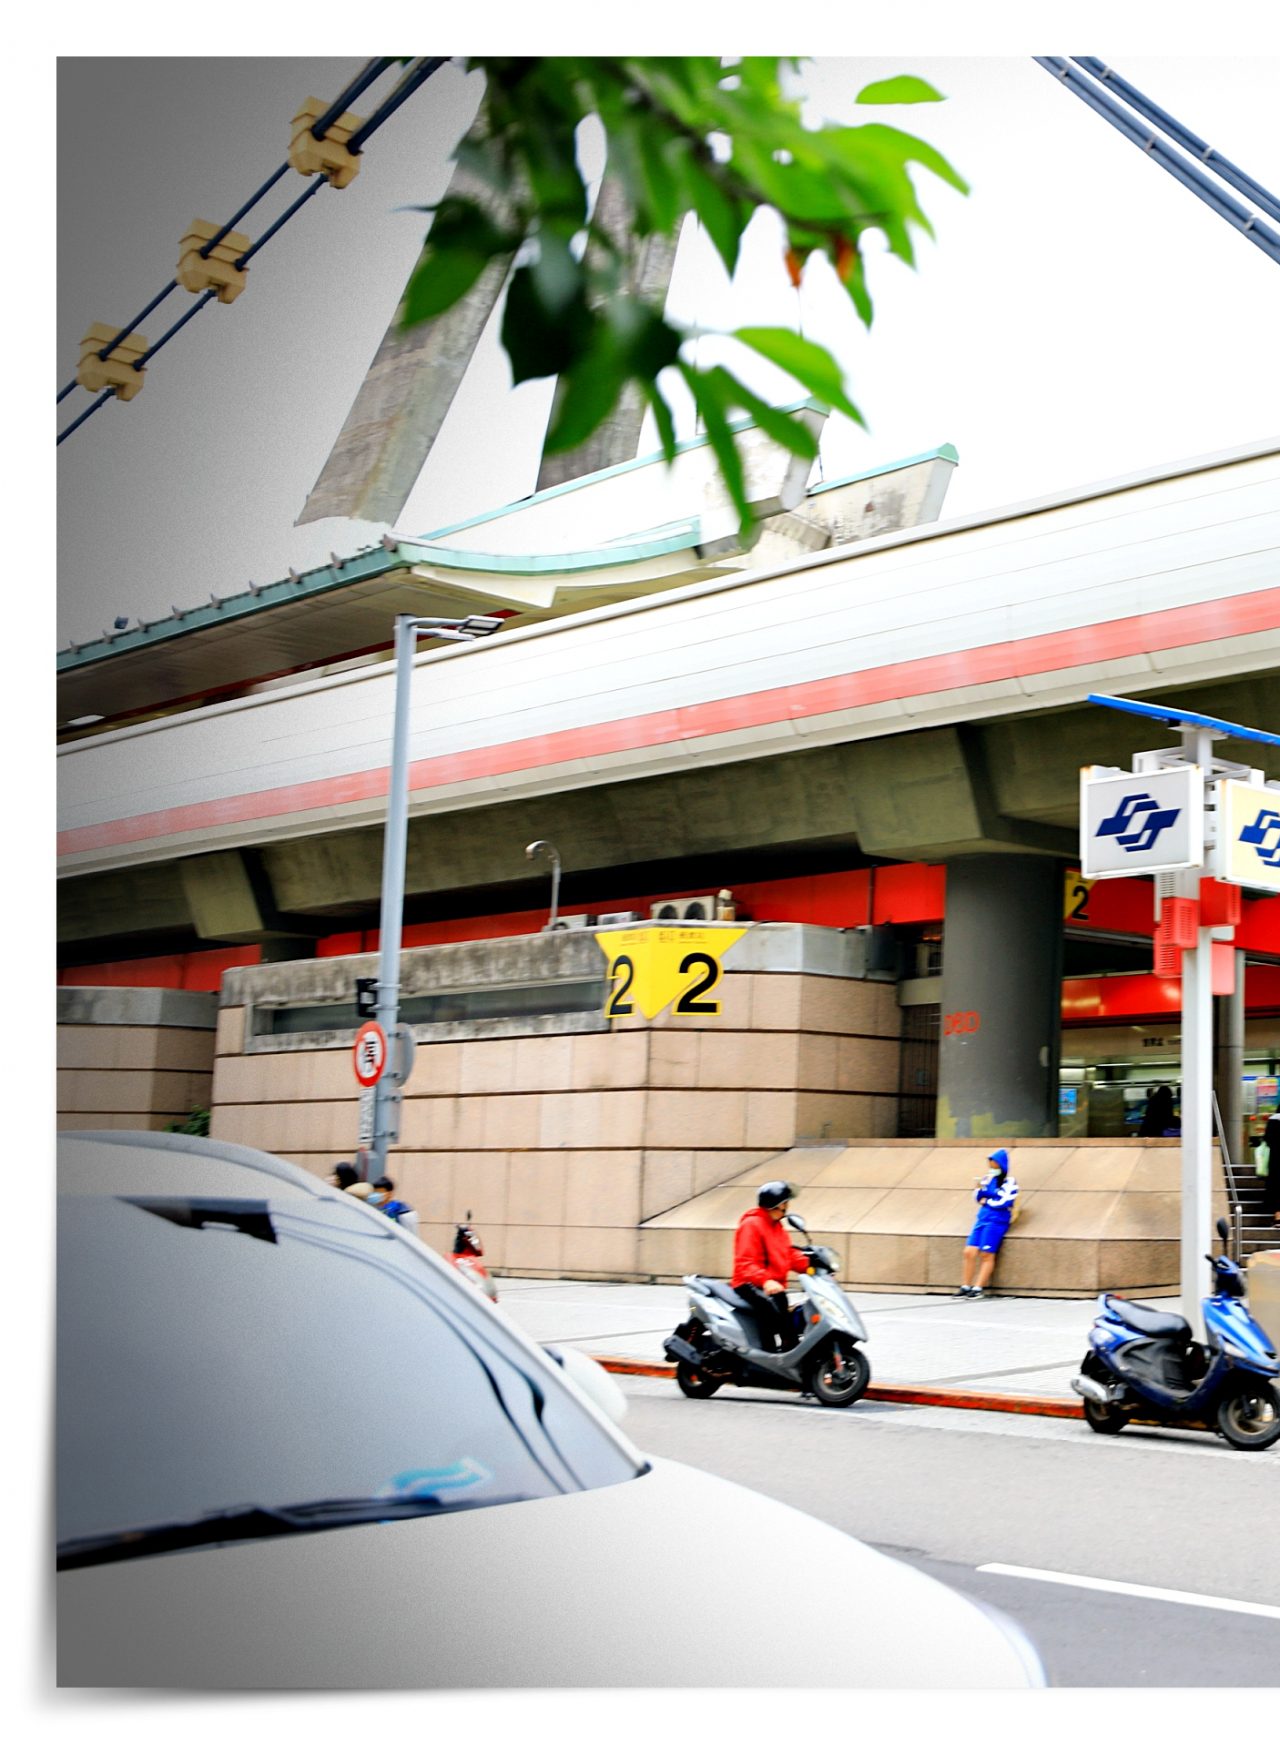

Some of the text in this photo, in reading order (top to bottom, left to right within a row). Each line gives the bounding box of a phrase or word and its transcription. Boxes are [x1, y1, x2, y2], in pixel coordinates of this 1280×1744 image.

[1071, 885, 1089, 921] 2
[609, 955, 634, 1015] 2
[677, 952, 718, 1013] 2
